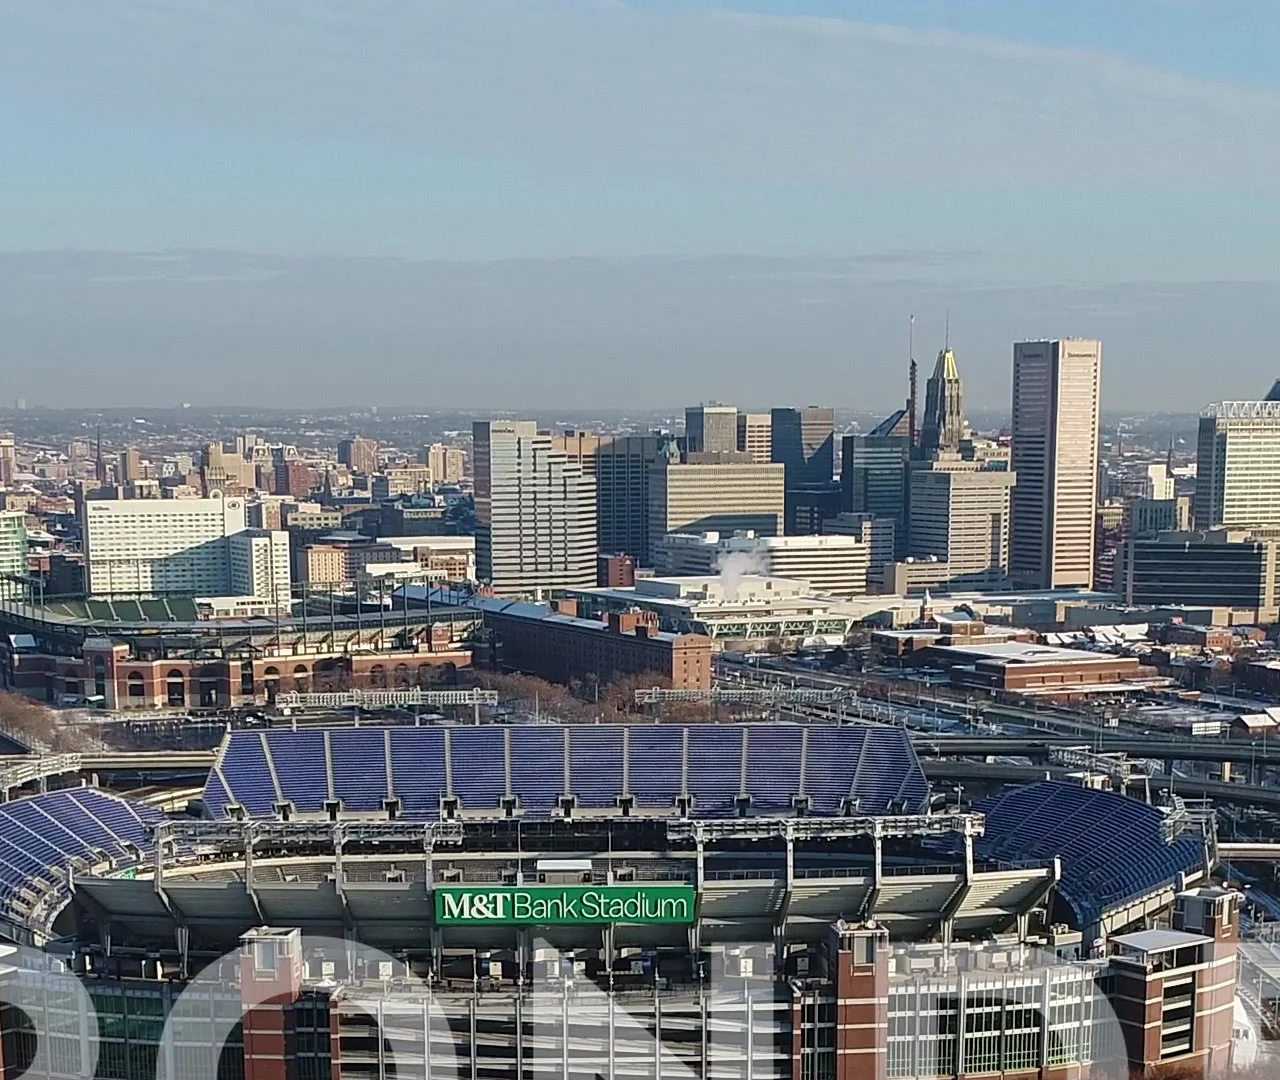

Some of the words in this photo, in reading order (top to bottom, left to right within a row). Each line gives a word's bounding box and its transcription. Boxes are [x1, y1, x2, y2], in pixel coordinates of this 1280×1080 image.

[442, 893, 511, 920] M&T
[514, 893, 578, 918] Bank
[581, 891, 687, 918] Stadium
